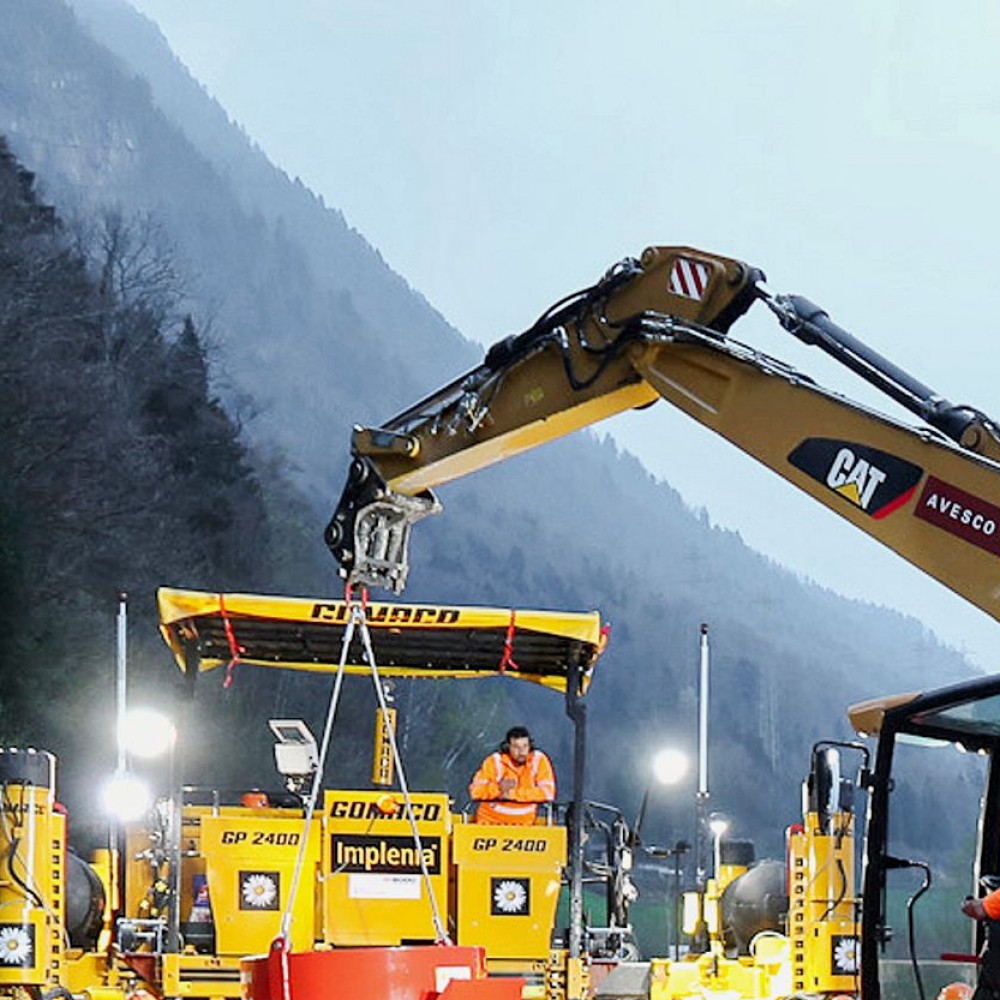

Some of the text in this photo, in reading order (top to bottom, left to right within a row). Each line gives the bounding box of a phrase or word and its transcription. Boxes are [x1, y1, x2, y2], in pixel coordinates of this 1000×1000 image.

[826, 447, 887, 509] CAT
[926, 493, 996, 535] AVESCO
[222, 831, 299, 846] GP 2400
[473, 838, 546, 852] GP 2400
